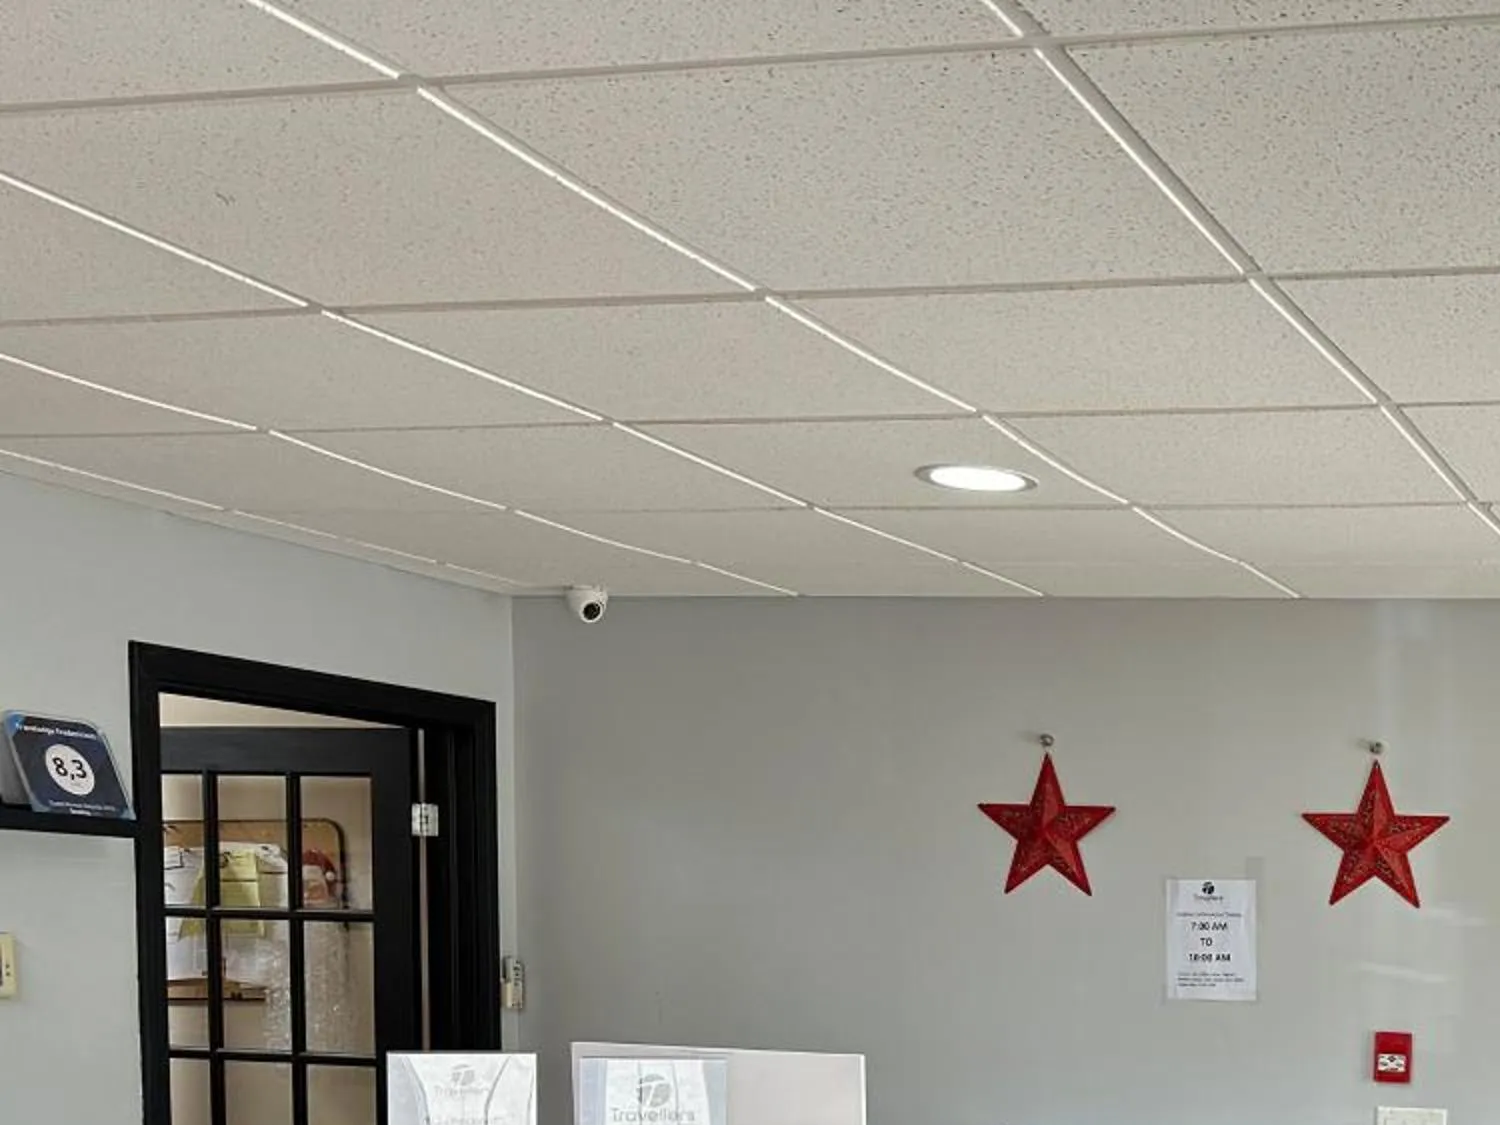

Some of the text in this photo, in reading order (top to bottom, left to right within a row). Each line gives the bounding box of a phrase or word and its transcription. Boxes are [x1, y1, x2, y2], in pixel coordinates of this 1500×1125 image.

[52, 756, 88, 781] 8,3
[1199, 937, 1213, 947] TO
[611, 1106, 696, 1123] Travellers
